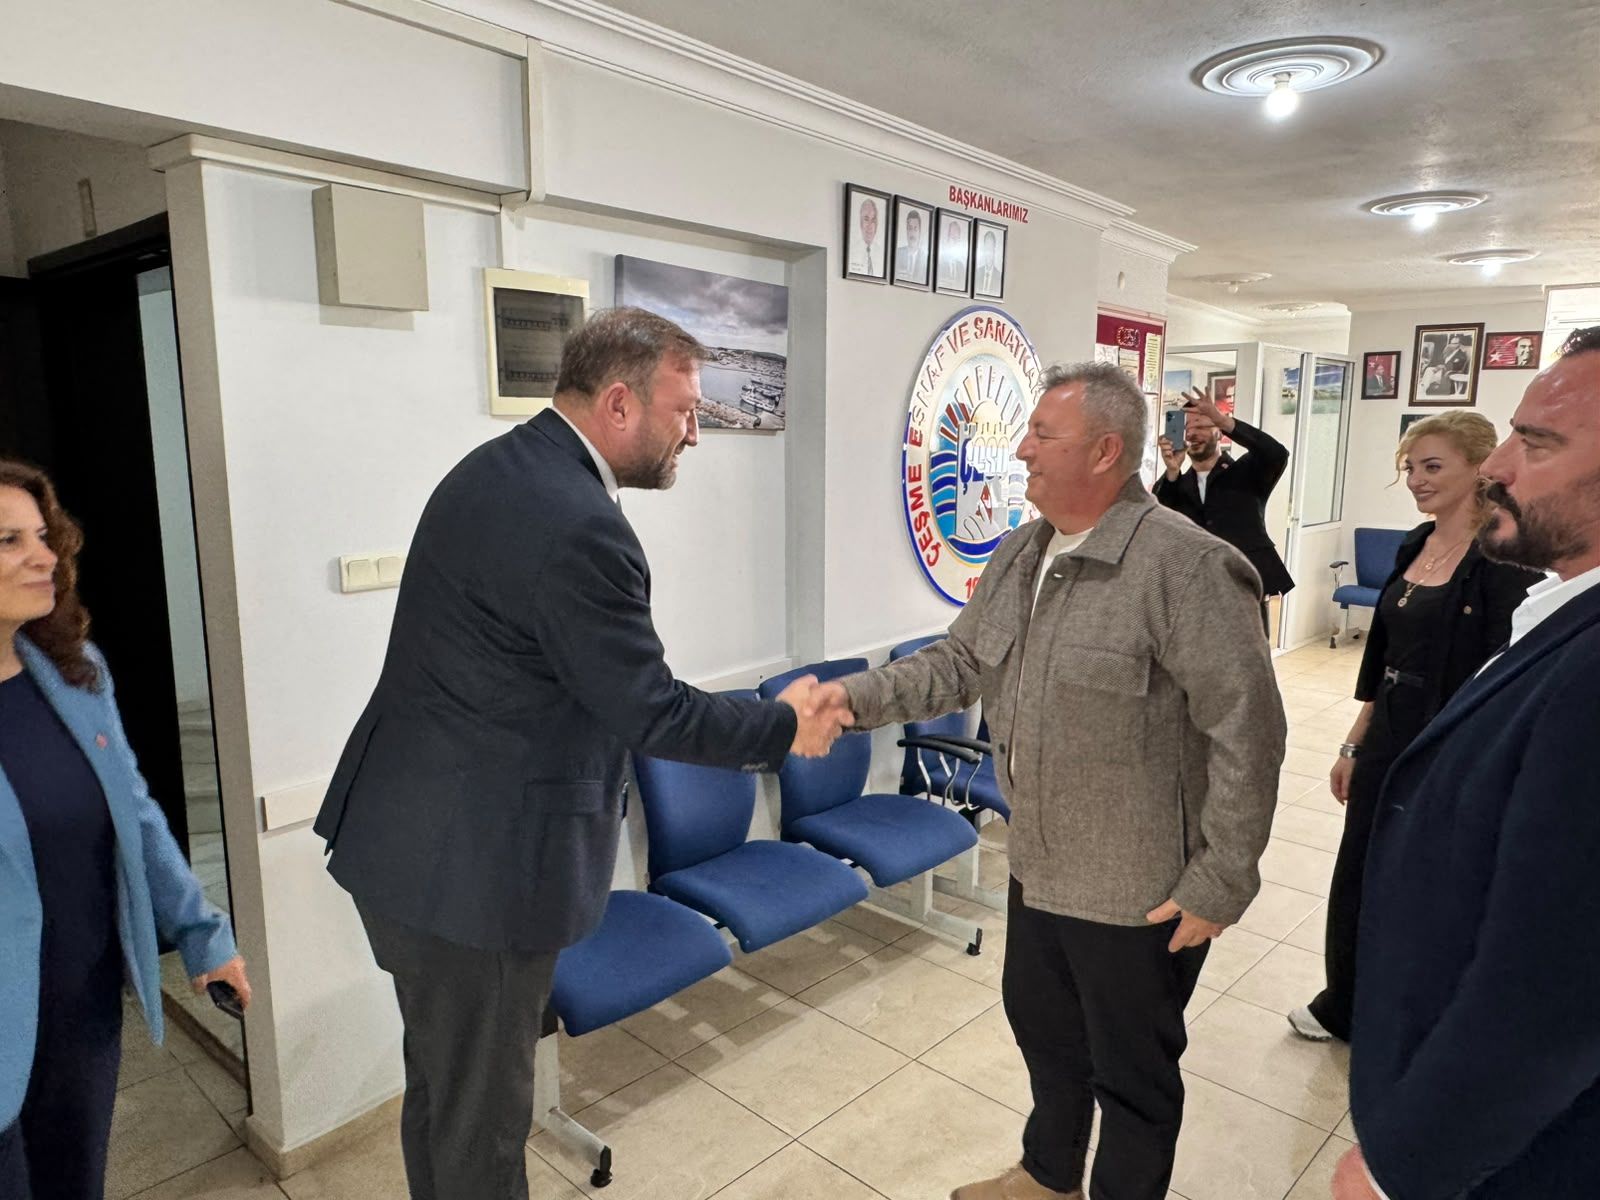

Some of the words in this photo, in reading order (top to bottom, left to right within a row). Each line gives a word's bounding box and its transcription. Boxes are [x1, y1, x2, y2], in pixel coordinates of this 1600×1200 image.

[949, 185, 1028, 223] BAŞKANLARIMIZ
[946, 321, 972, 354] VE
[908, 344, 945, 447] ESNAF
[908, 464, 942, 567] ÇEŞME
